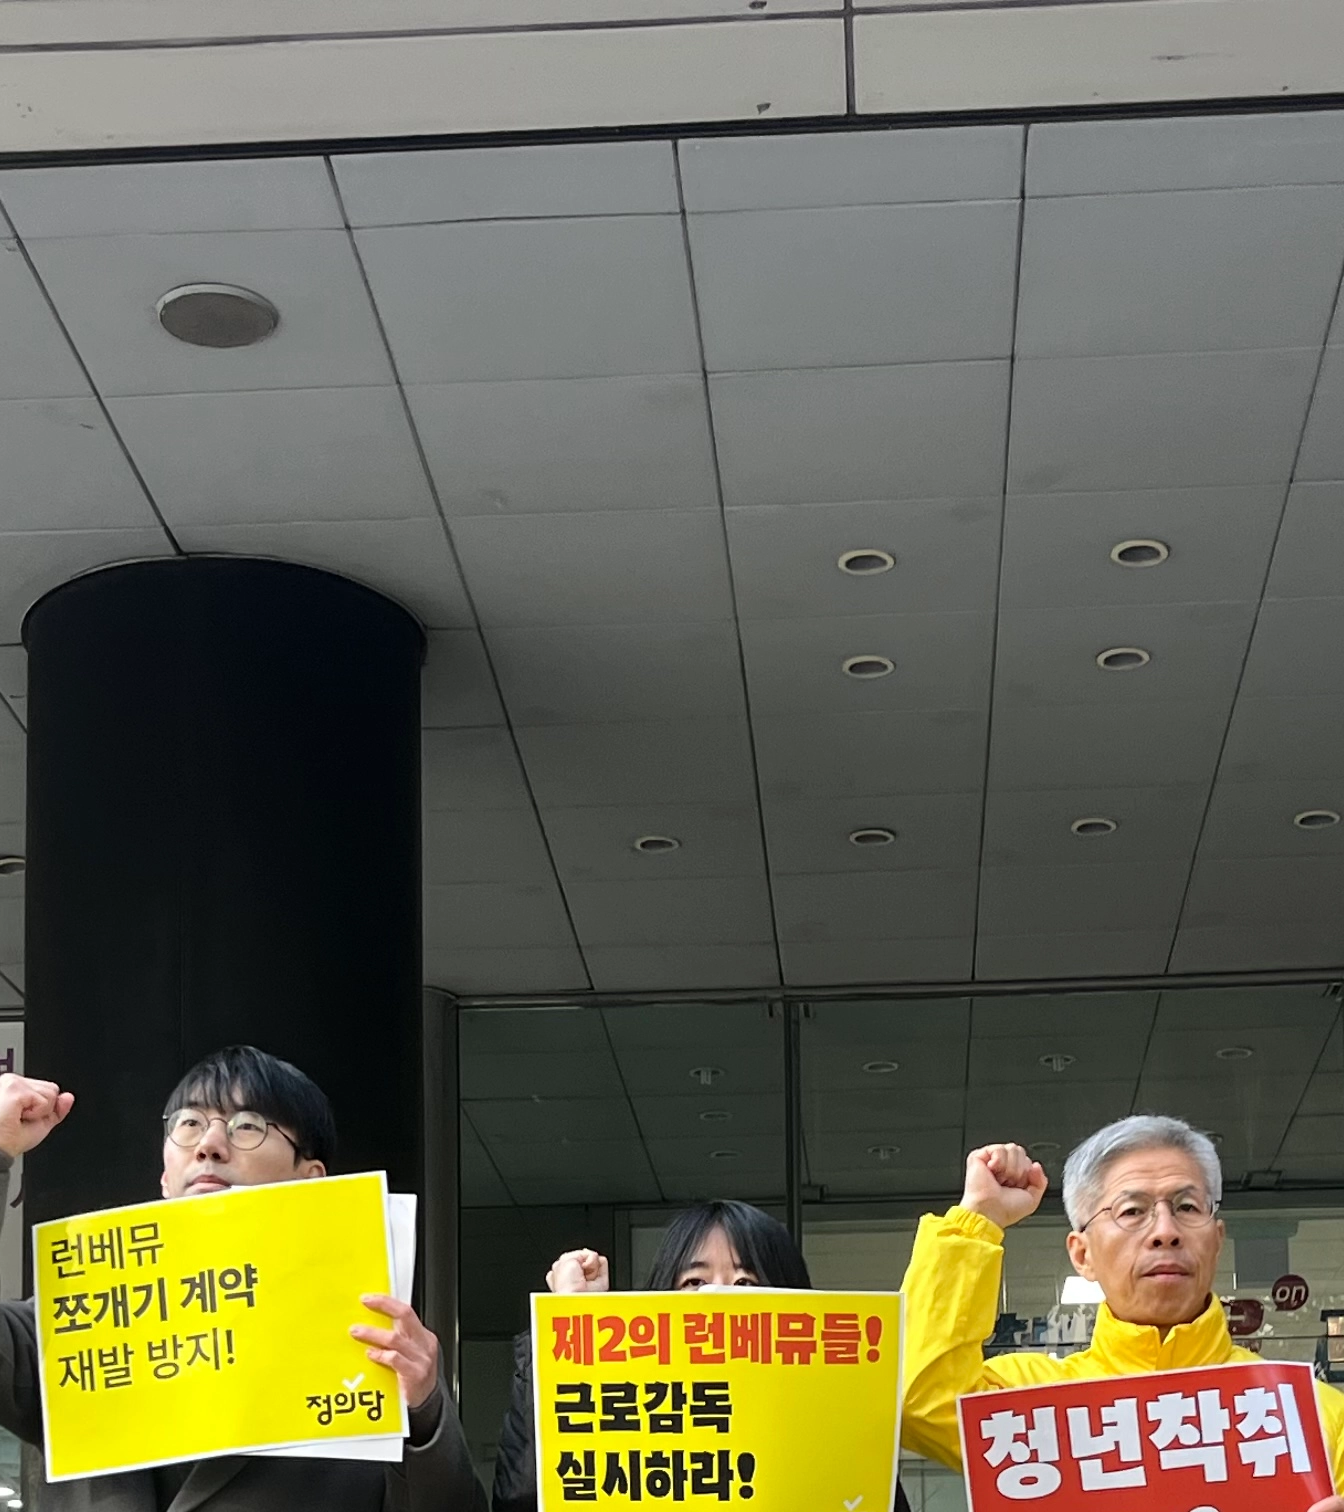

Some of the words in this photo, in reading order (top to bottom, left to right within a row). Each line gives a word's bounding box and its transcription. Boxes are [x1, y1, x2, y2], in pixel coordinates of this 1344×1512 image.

[50, 1221, 165, 1279] 런베뮤
[52, 1277, 169, 1335] 쪼개기
[180, 1262, 258, 1316] 계약
[57, 1342, 135, 1393] 재발
[146, 1328, 236, 1380] 방지!
[552, 1312, 672, 1366] 제2의
[683, 1311, 884, 1366] 런베뮤들!
[305, 1388, 385, 1426] 정의당
[554, 1380, 734, 1435] 근로감독
[979, 1382, 1312, 1501] 청년착취
[555, 1449, 757, 1502] 실시하라!
